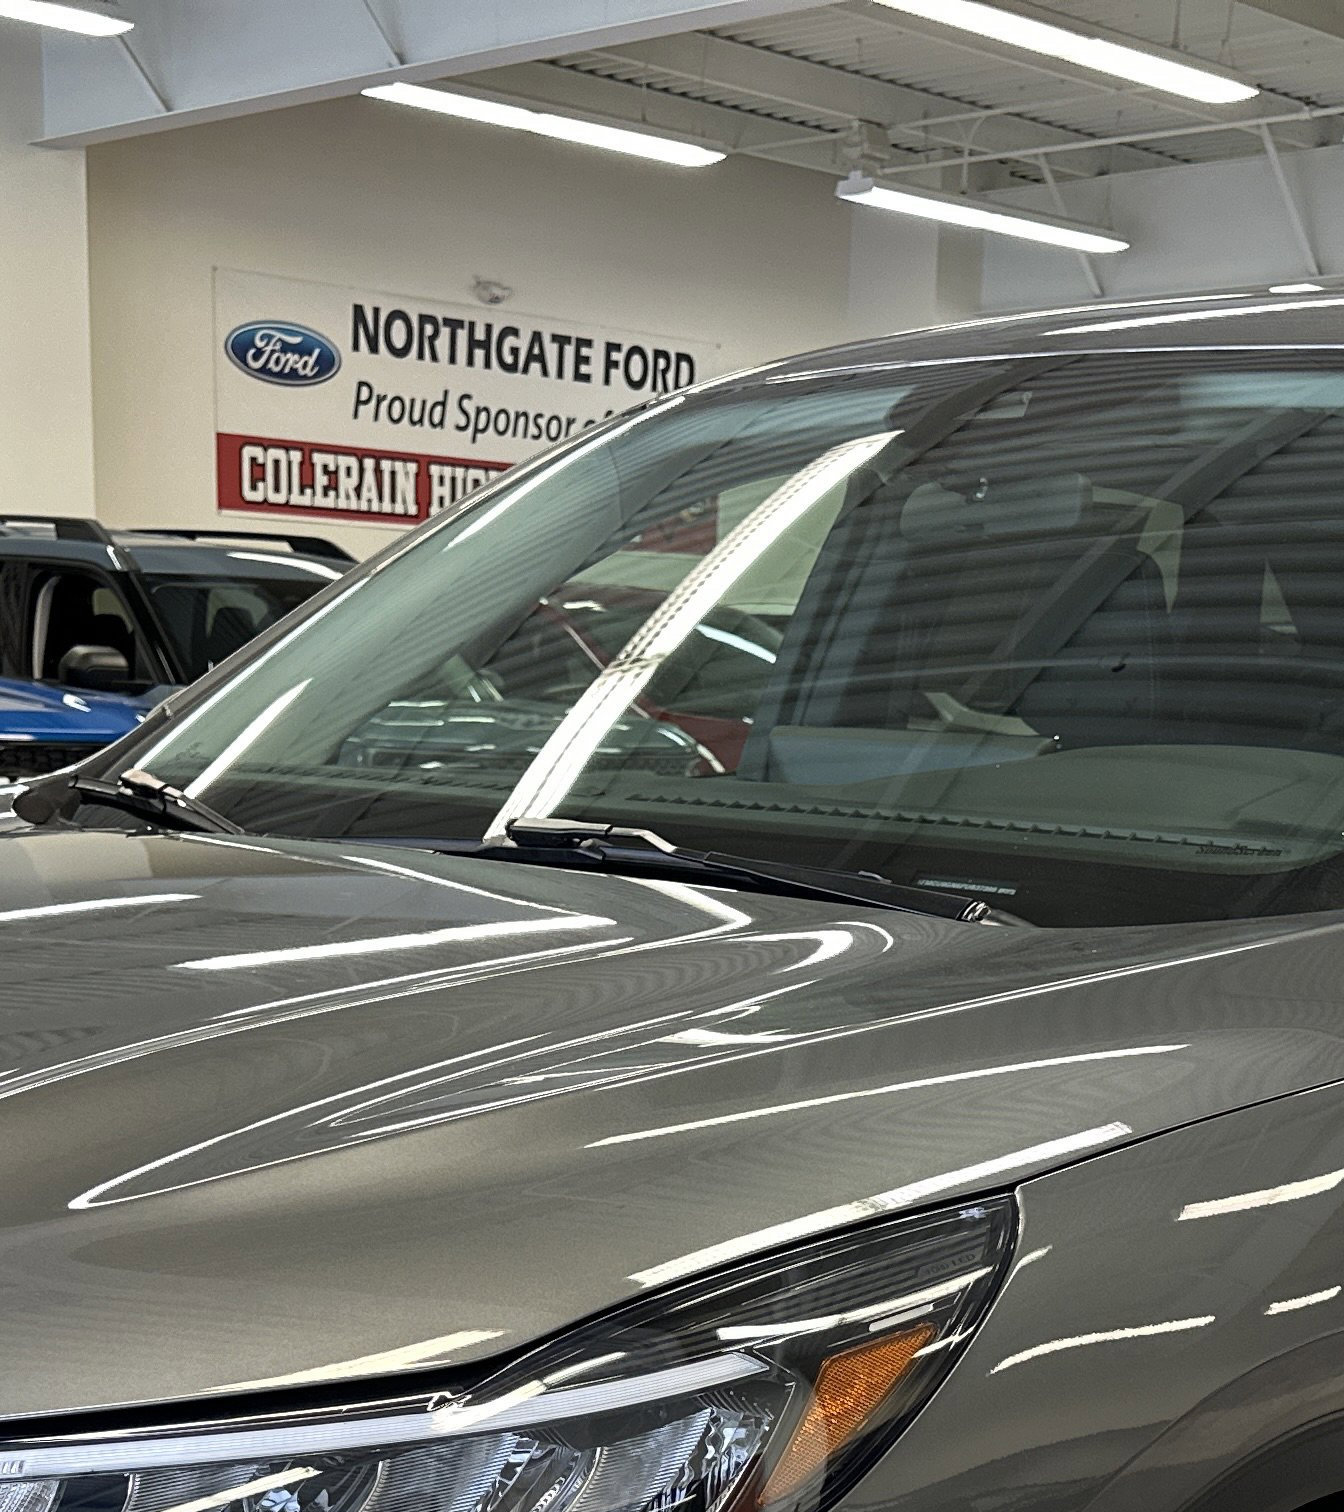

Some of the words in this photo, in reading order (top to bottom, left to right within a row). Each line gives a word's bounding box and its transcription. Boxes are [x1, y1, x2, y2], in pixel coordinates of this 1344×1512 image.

[245, 328, 322, 378] Ford
[351, 303, 594, 384] NORTHGATE
[603, 341, 696, 394] FORD
[351, 380, 450, 430] Proud
[454, 393, 577, 444] Sponsor
[241, 444, 419, 517] COLERAIN
